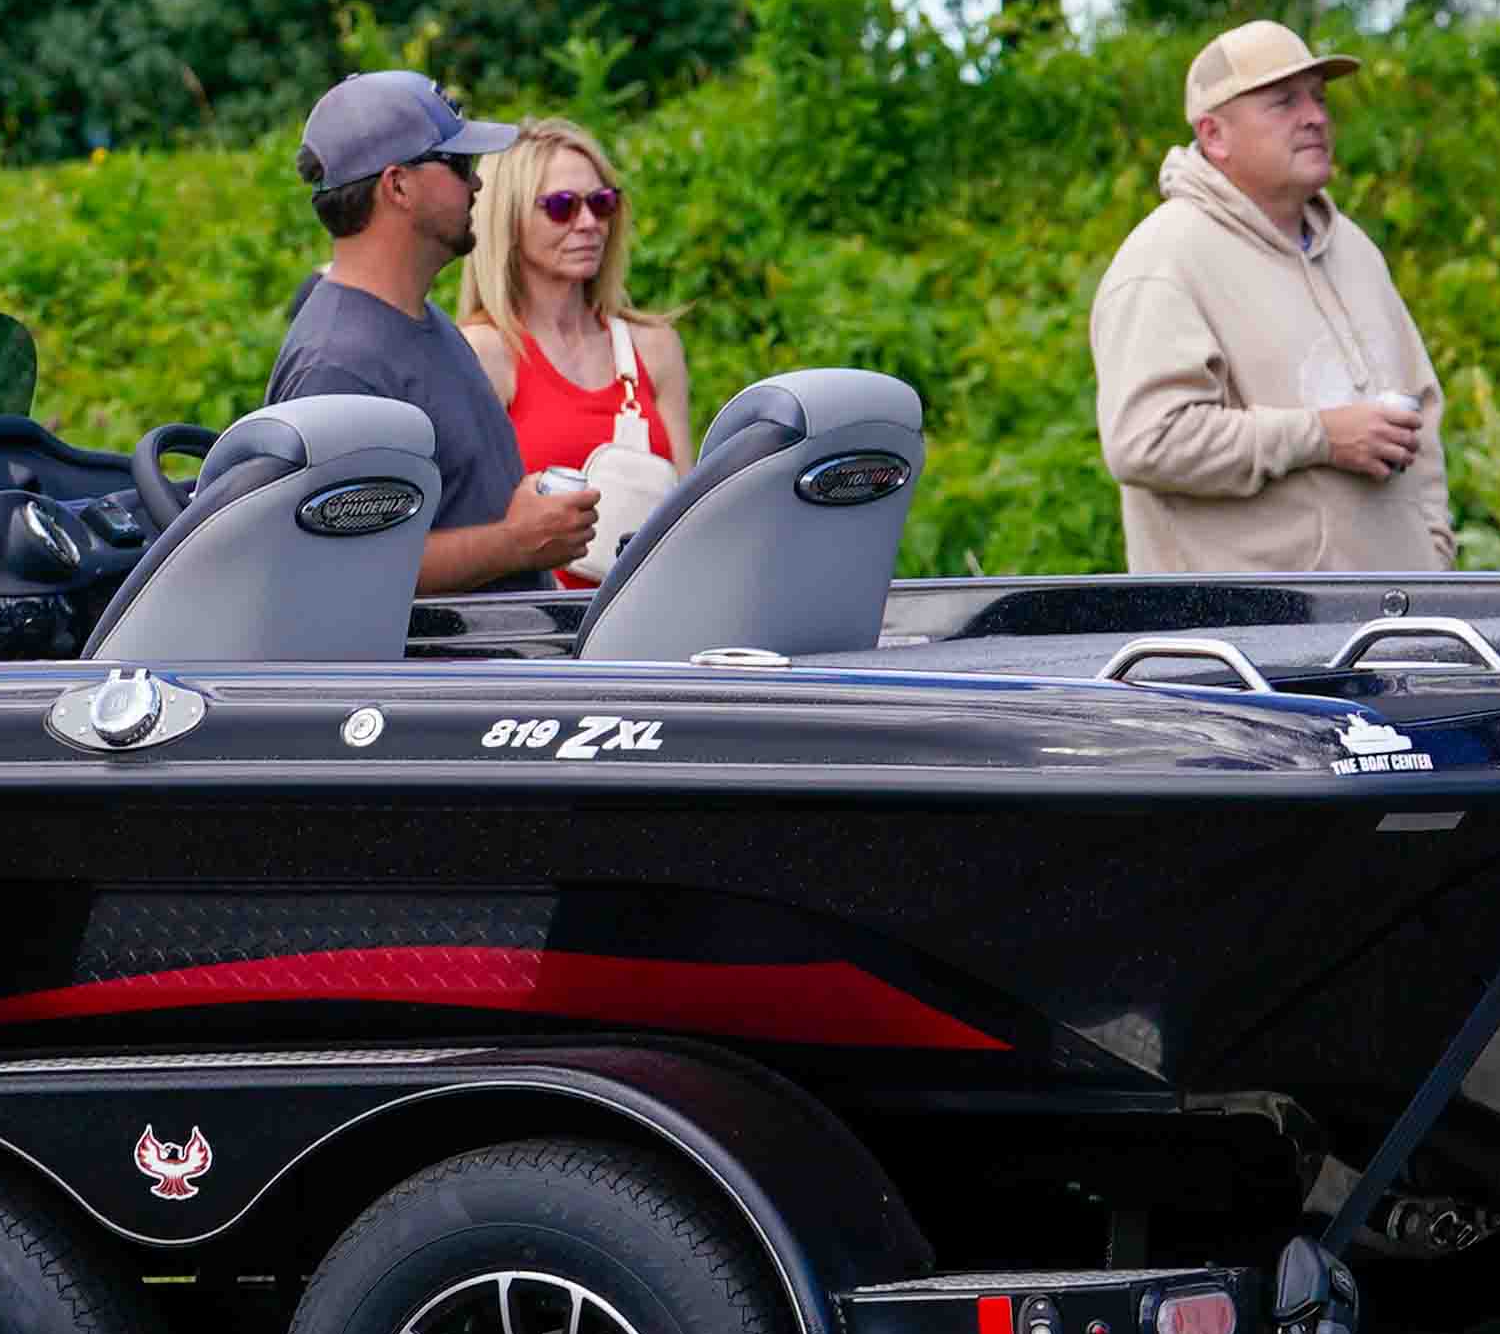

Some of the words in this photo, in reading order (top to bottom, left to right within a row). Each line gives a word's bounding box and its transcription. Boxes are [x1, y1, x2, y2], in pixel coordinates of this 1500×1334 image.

[481, 719, 560, 748] 819
[555, 716, 664, 759] ZXL
[1330, 758, 1359, 775] THE
[1358, 755, 1391, 771] BOAT
[1390, 753, 1434, 770] CENTER
